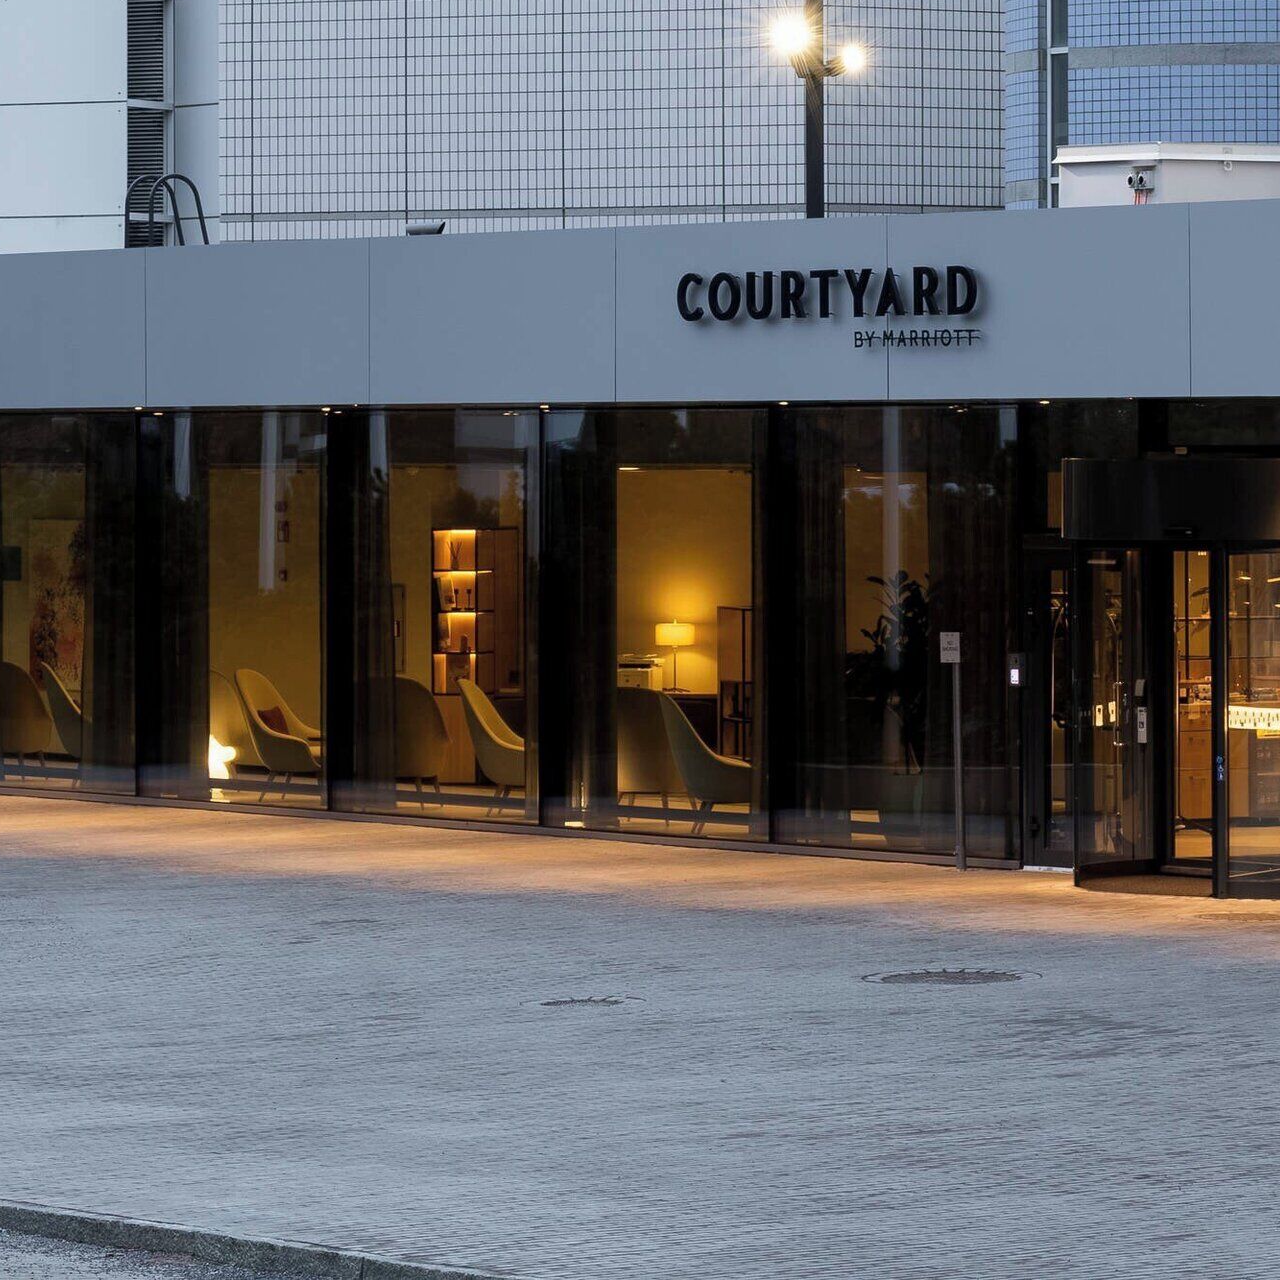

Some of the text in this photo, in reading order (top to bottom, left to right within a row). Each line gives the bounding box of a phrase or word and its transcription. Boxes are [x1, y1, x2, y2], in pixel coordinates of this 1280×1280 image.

[677, 266, 978, 322] COURTYARD
[854, 329, 976, 348] BY MARRIOTT
